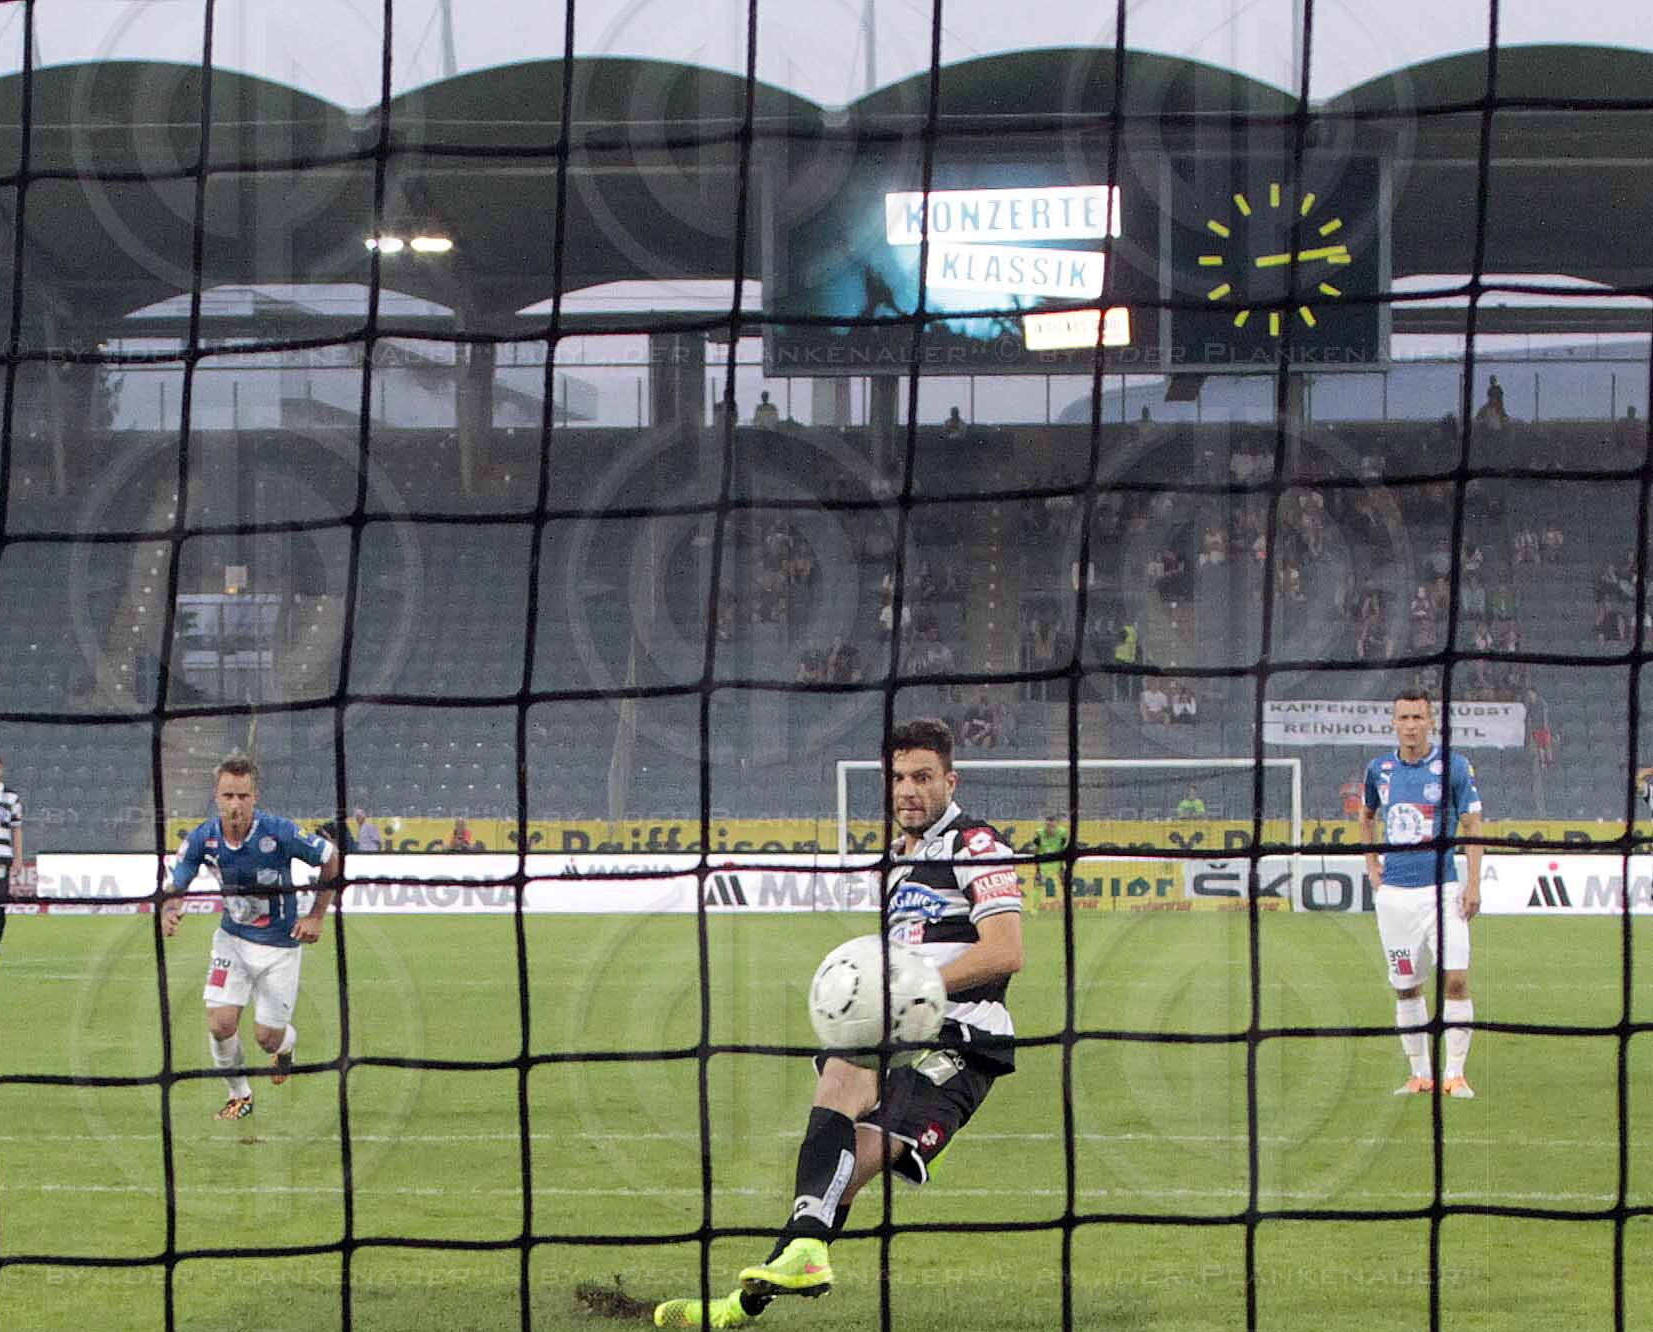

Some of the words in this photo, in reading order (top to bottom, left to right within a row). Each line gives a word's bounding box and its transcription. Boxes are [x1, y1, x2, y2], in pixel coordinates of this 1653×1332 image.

[905, 197, 1099, 234] KONZERTE
[942, 252, 1087, 288] KLASSIK
[1269, 702, 1394, 716] KAPFENSTE
[1283, 722, 1393, 736] REINHOLD
[353, 873, 530, 908] MAGNA
